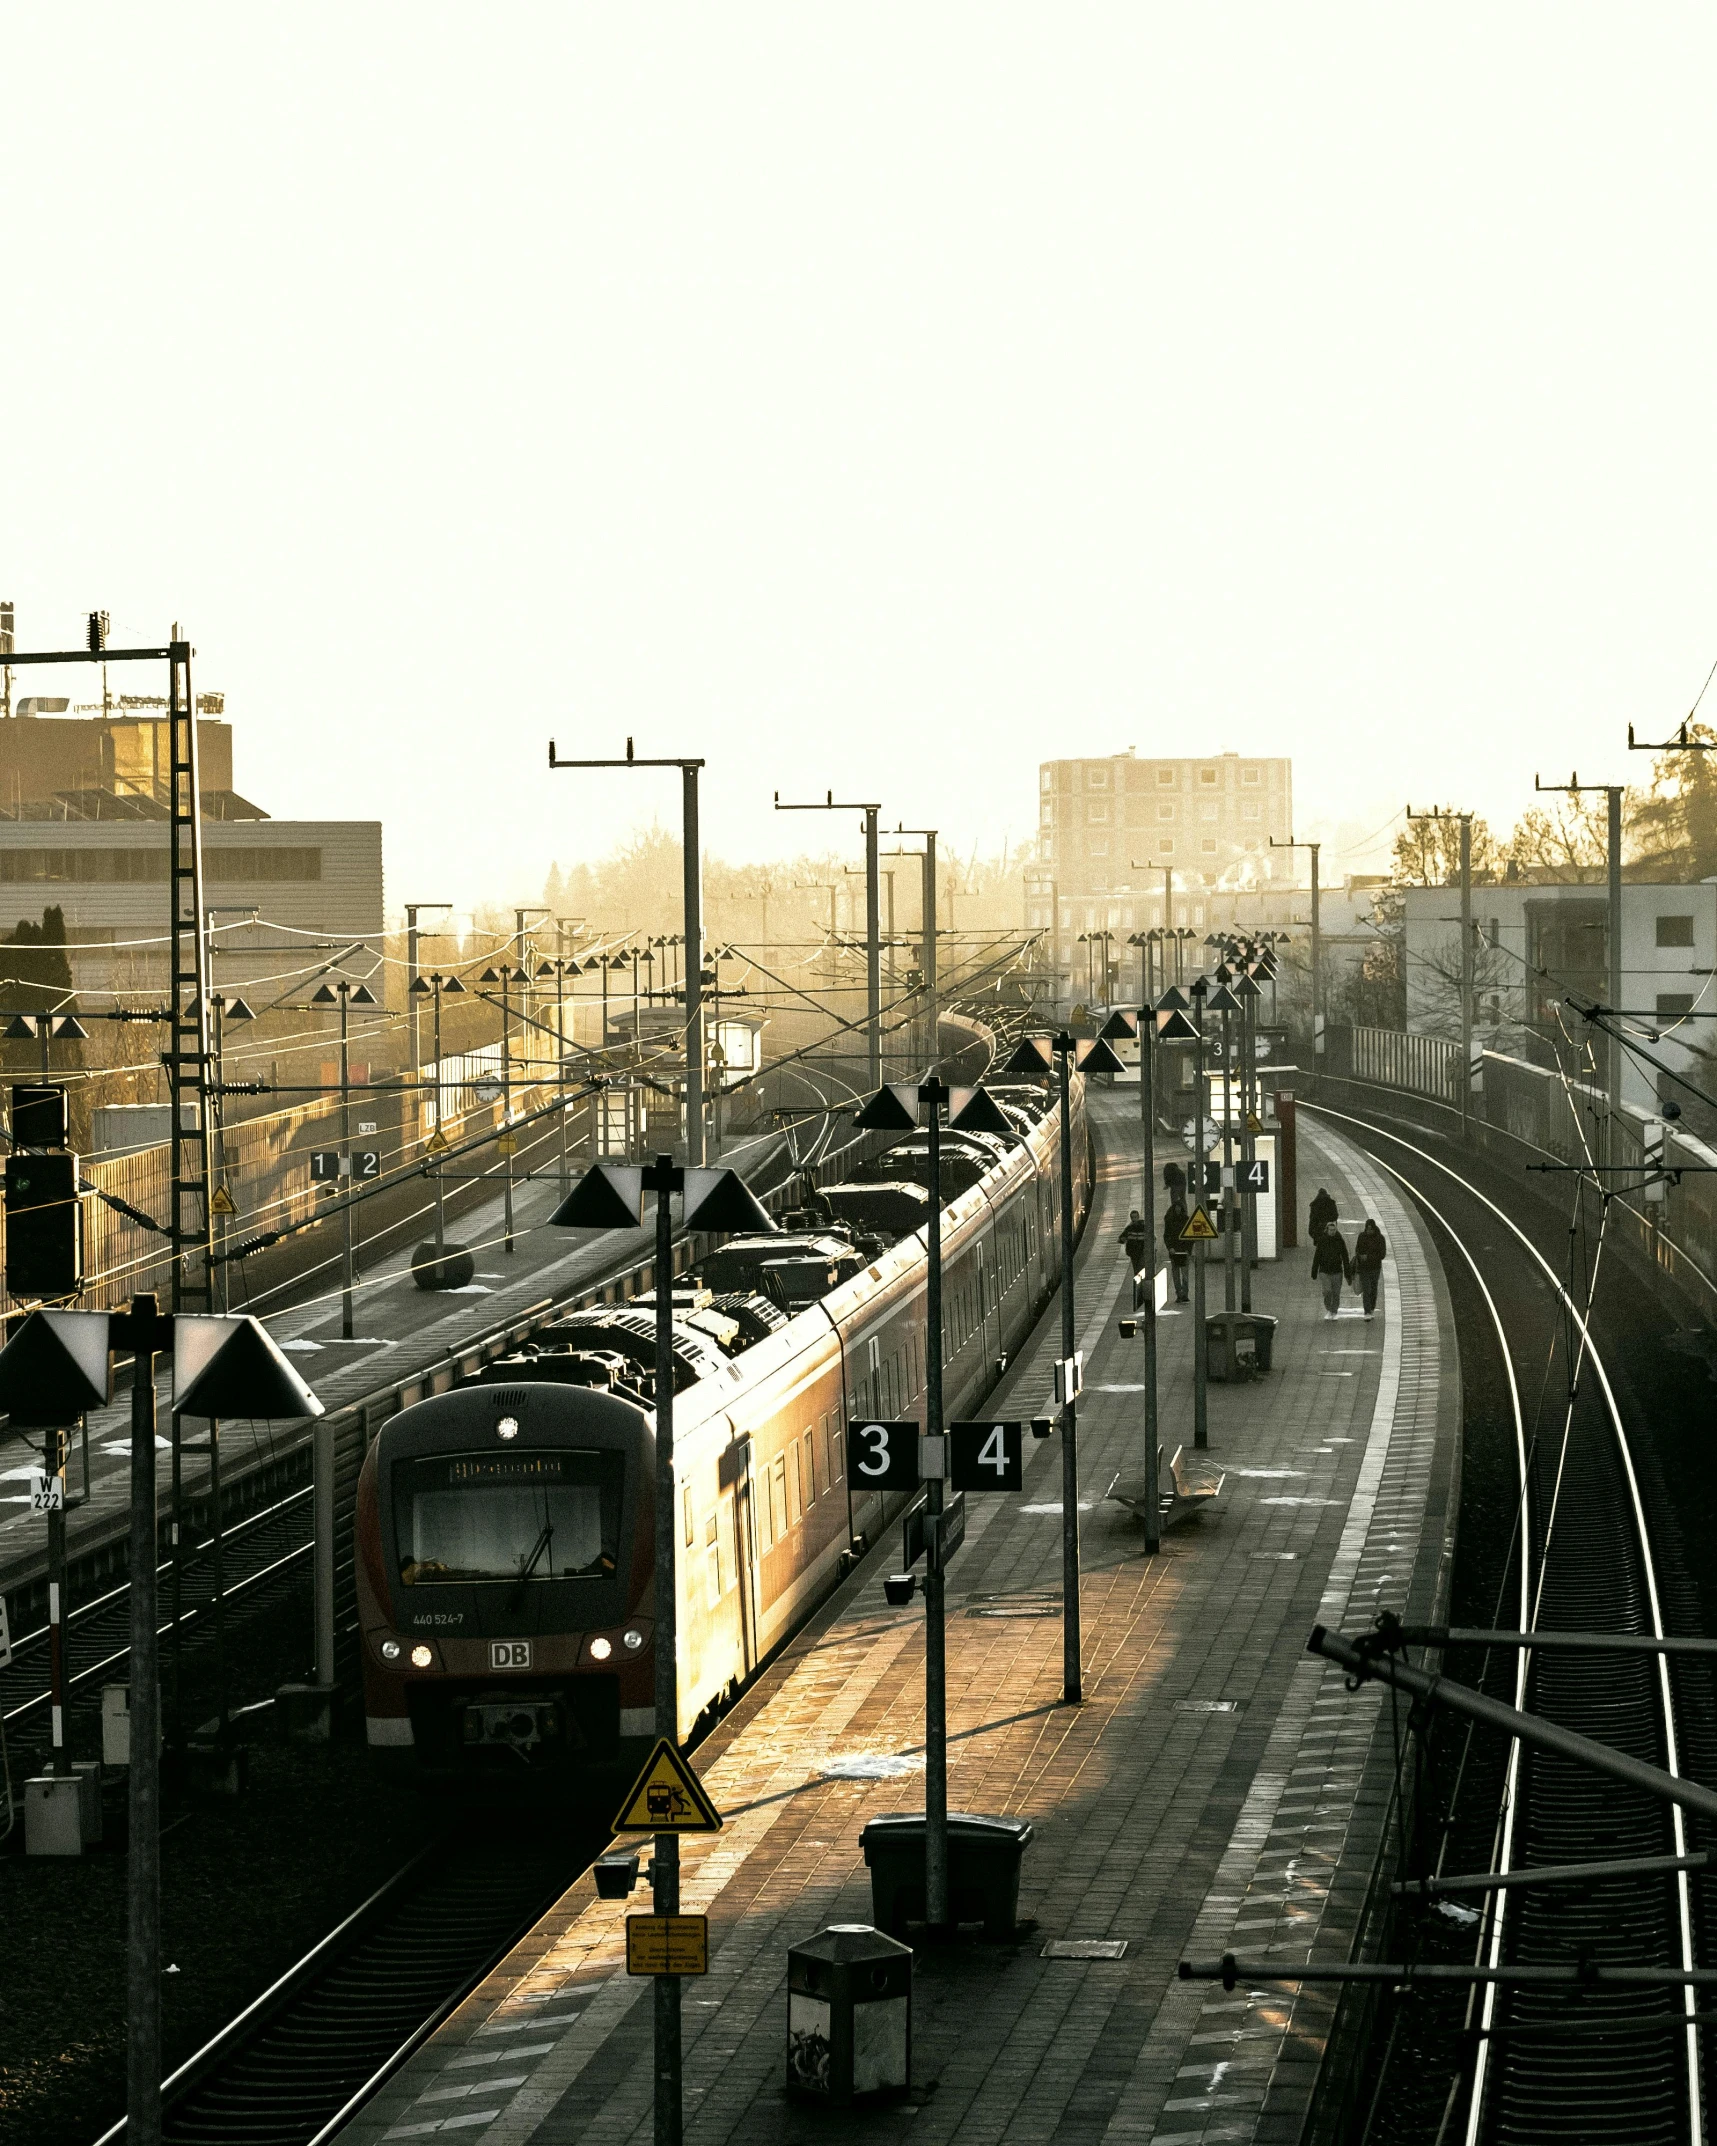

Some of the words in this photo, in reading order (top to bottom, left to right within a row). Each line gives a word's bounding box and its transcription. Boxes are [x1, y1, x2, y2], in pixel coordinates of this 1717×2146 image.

[1213, 1042, 1222, 1056] 3
[359, 1124, 375, 1132] LZB
[314, 1153, 324, 1174] 1
[363, 1152, 377, 1174] 2
[1248, 1162, 1264, 1186] 4
[857, 1424, 891, 1476] 3
[977, 1425, 1010, 1476] 4
[39, 1476, 53, 1493] W
[34, 1493, 59, 1509] 222
[413, 1614, 433, 1625] 440
[434, 1613, 464, 1625] 524-7
[493, 1643, 529, 1667] DB
